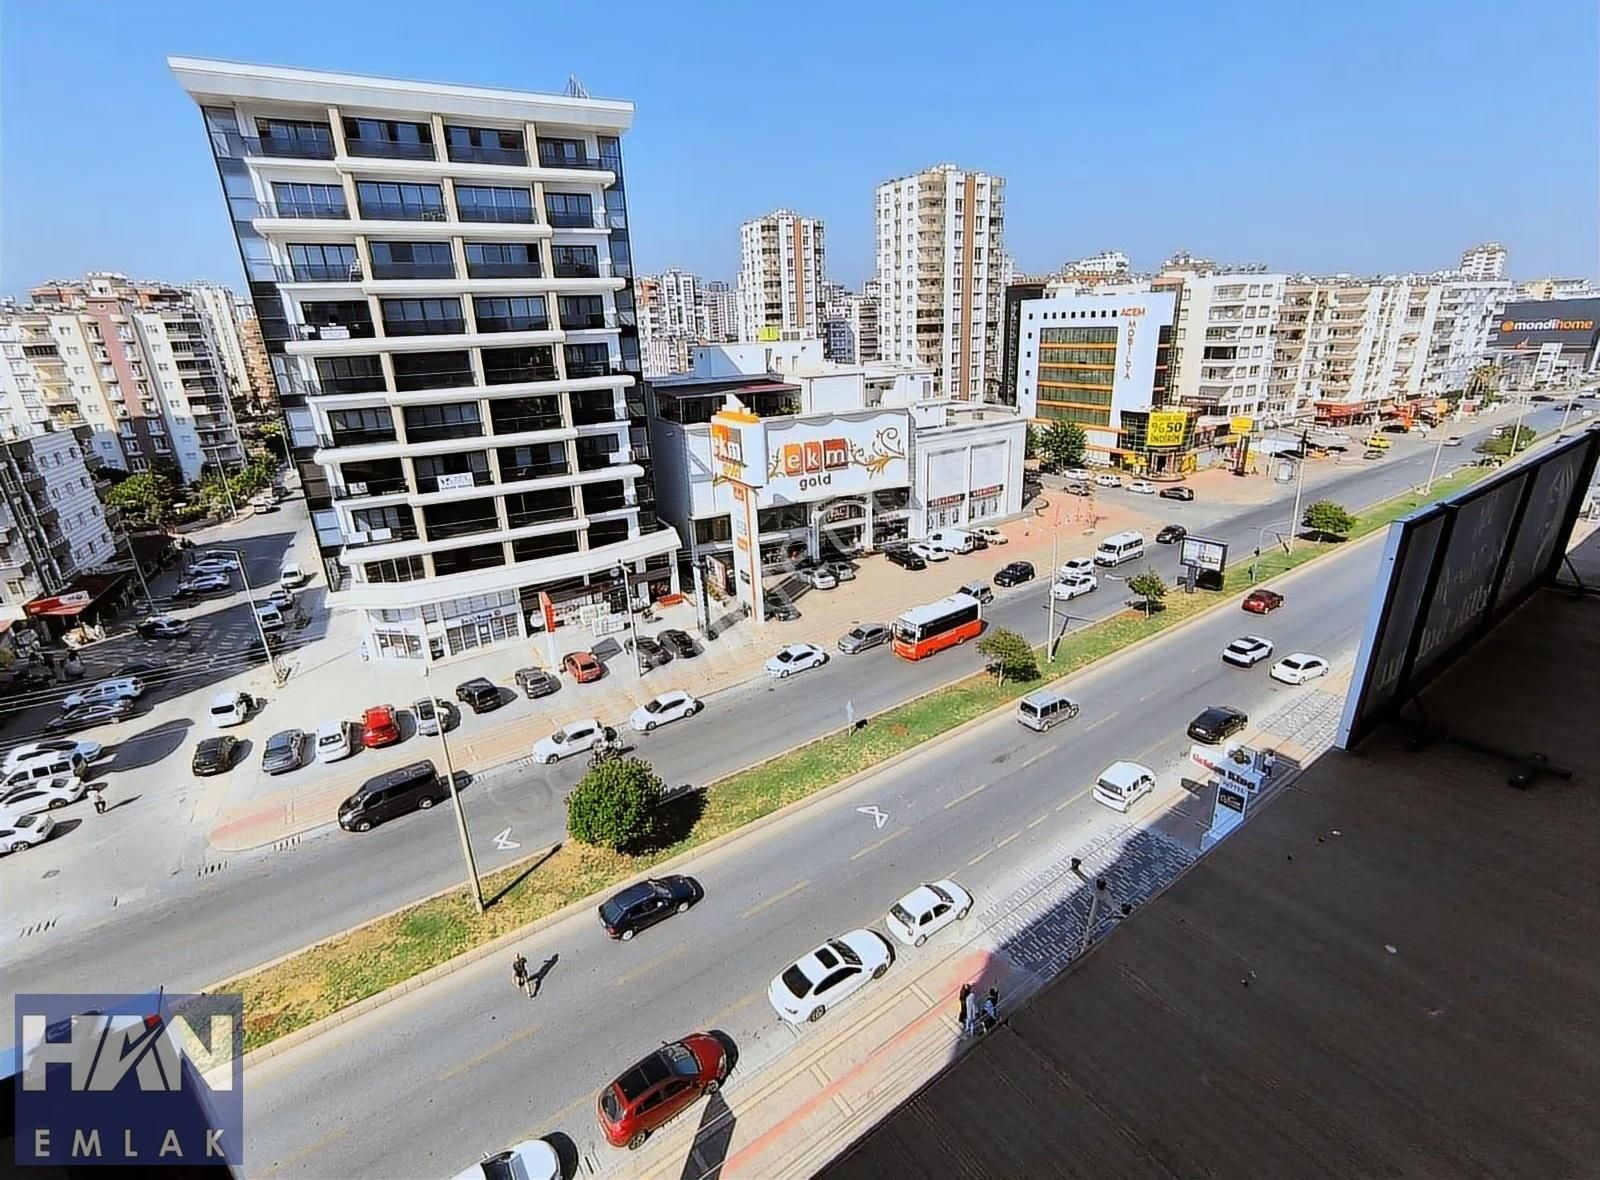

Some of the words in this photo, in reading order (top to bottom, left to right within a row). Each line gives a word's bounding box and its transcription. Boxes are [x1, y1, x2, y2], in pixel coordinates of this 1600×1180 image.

[1514, 319, 1594, 331] mondihome
[787, 446, 847, 469] ekm
[800, 474, 832, 491] gold
